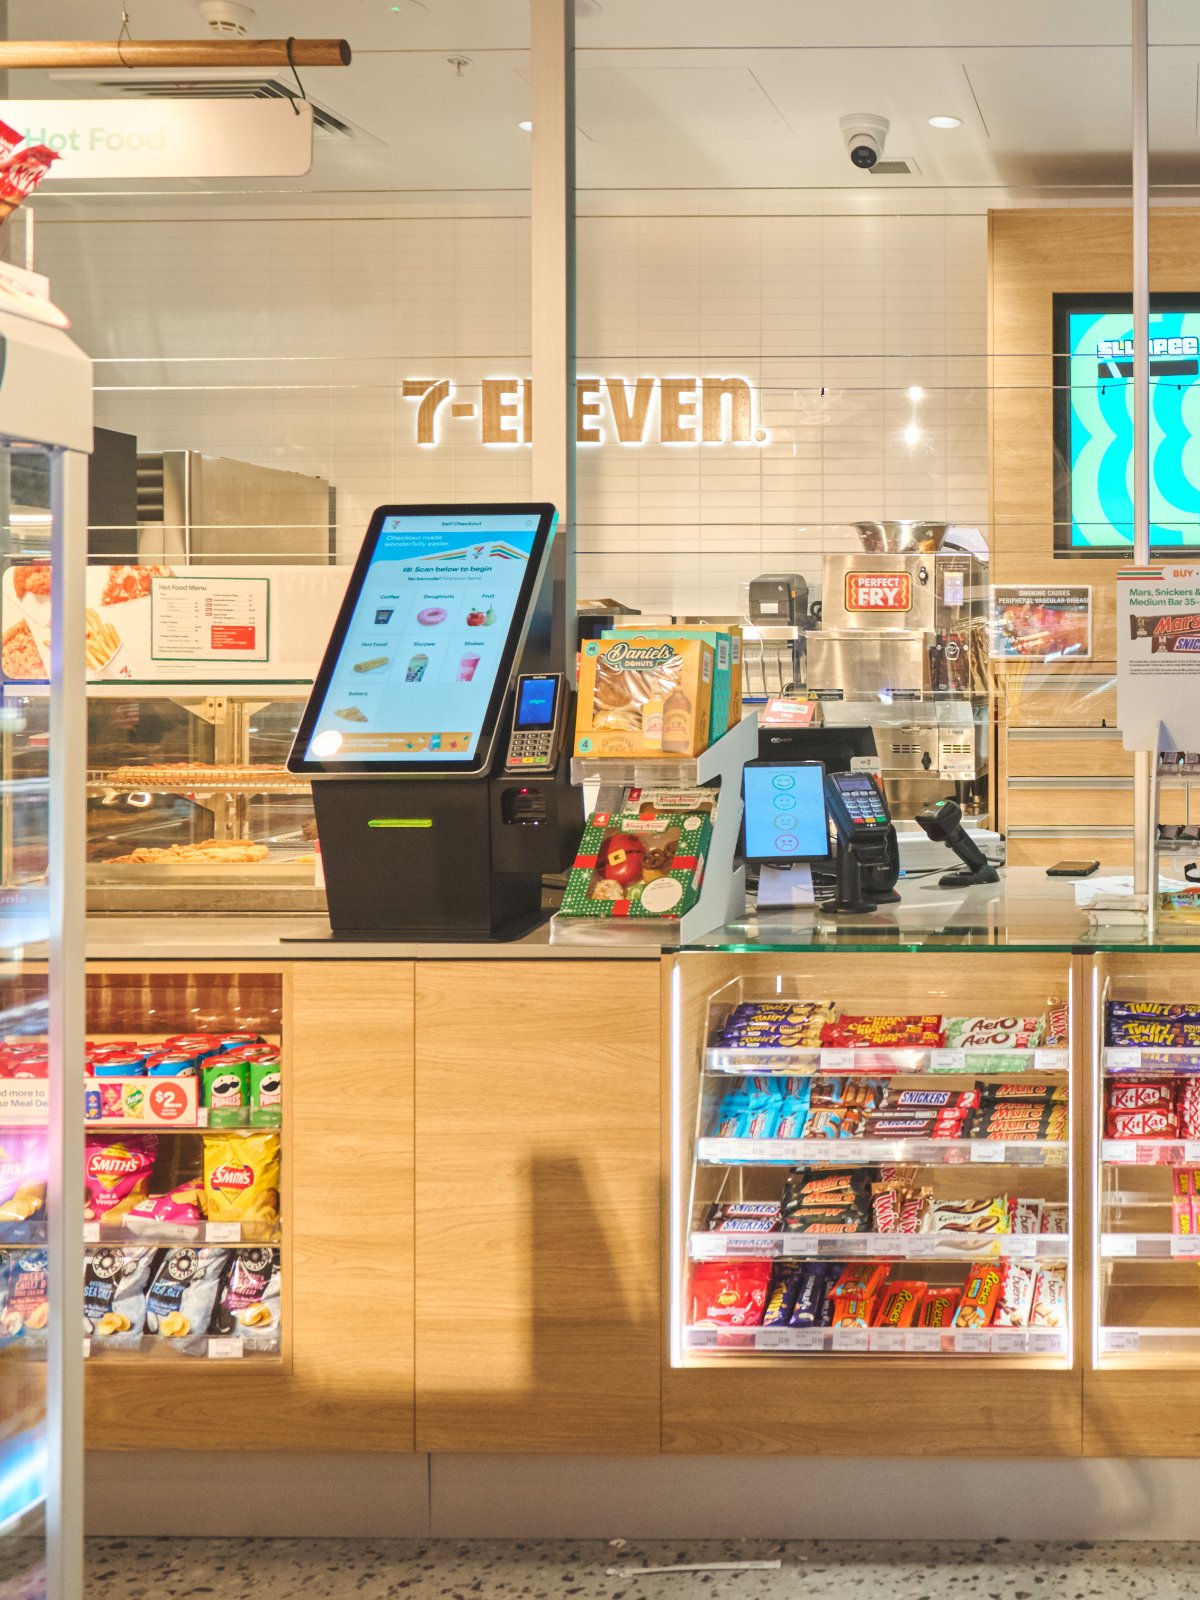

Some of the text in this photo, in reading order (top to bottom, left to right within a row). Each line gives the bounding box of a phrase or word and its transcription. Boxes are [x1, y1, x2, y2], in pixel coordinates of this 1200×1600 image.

[25, 127, 166, 151] Hot Food
[470, 566, 492, 574] begin
[1173, 569, 1193, 578] BUY
[858, 578, 900, 587] PERFECT
[858, 587, 898, 606] FRY
[1130, 588, 1152, 597] Mars,
[1155, 588, 1194, 596] Snickers
[1130, 598, 1166, 606] Medium
[1168, 598, 1183, 606] Bar
[582, 740, 588, 748] 4
[1124, 1002, 1172, 1015] Twirl
[971, 1018, 1017, 1032] Aero
[155, 1091, 175, 1109] $2
[212, 1095, 240, 1107] PRINGLES
[901, 1092, 948, 1104] SNICKERS
[1115, 1088, 1159, 1107] KitKat
[991, 1110, 1043, 1120] Mars
[89, 1156, 139, 1172] SMITH'S
[213, 1169, 250, 1184] SMITH'S
[978, 1271, 999, 1306] Reese's
[1013, 1276, 1024, 1305] bueno
